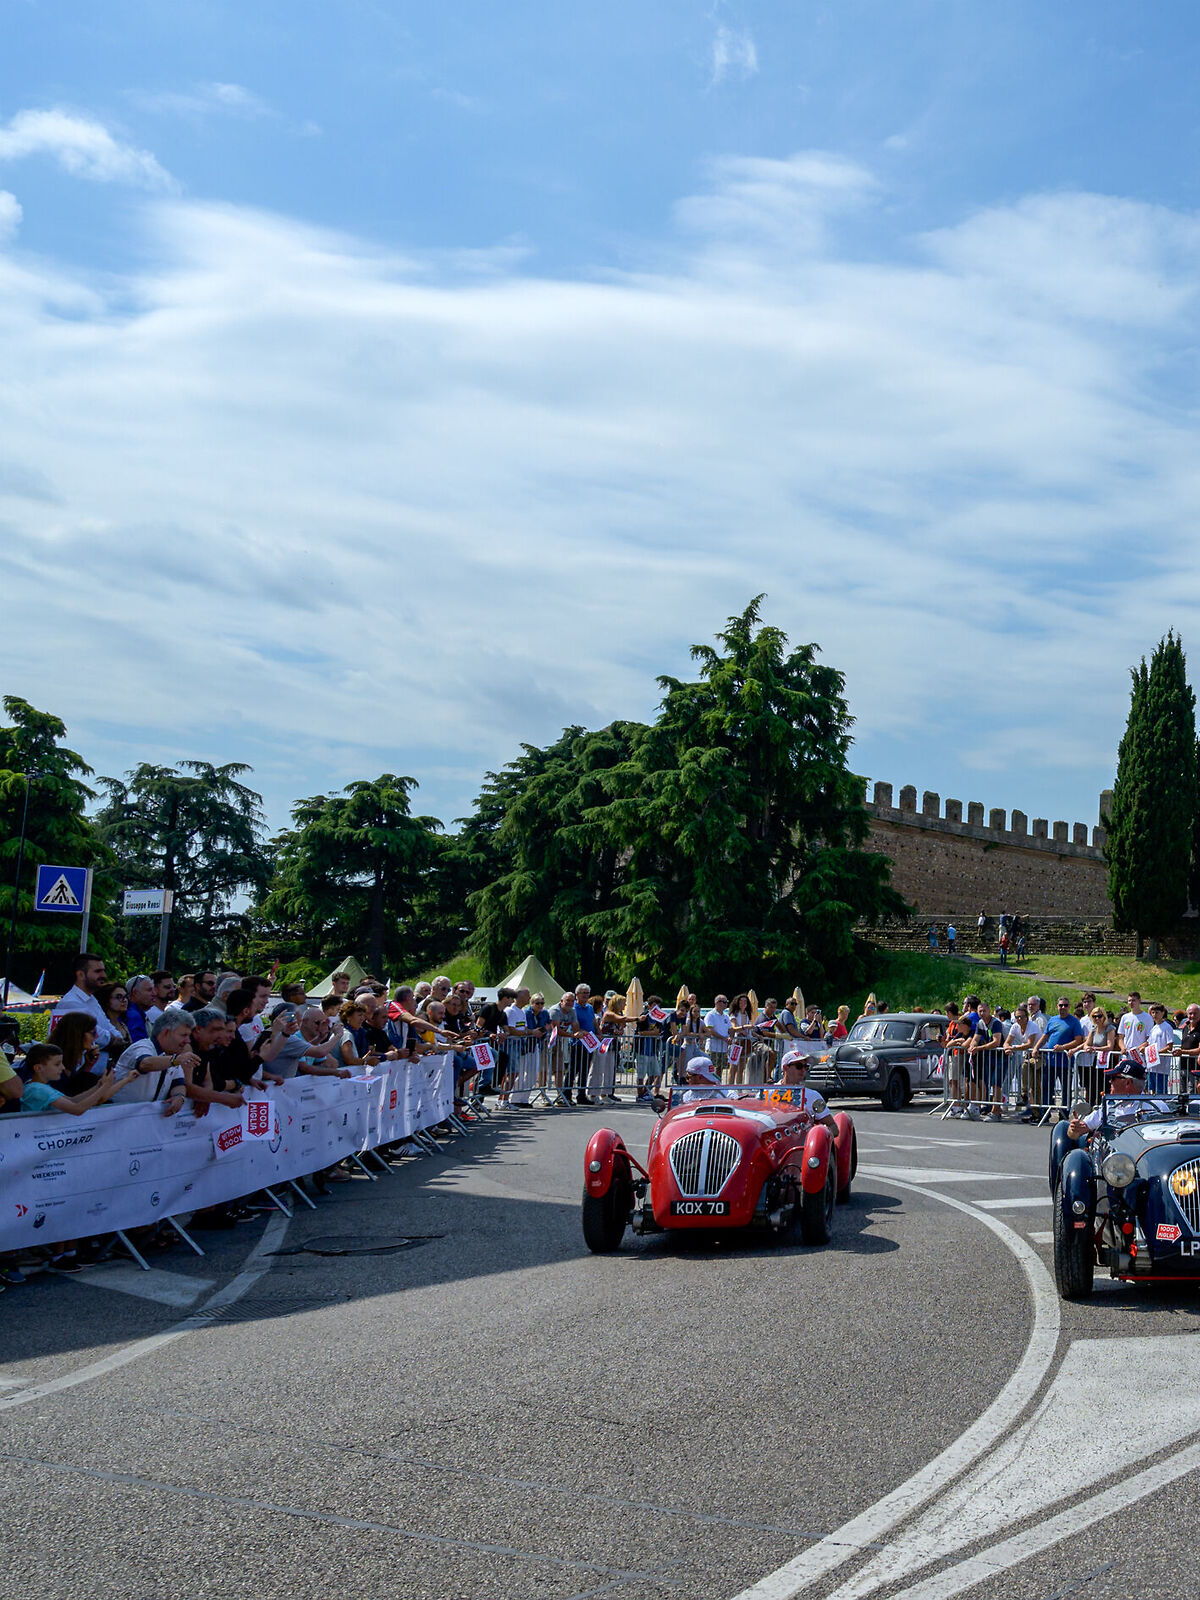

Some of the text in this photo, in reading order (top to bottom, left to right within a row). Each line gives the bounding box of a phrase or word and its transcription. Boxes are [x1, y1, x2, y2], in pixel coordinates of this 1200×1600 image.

[762, 1089, 793, 1103] 164
[38, 1135, 93, 1150] CHOPARD
[676, 1202, 725, 1214] KOX 70
